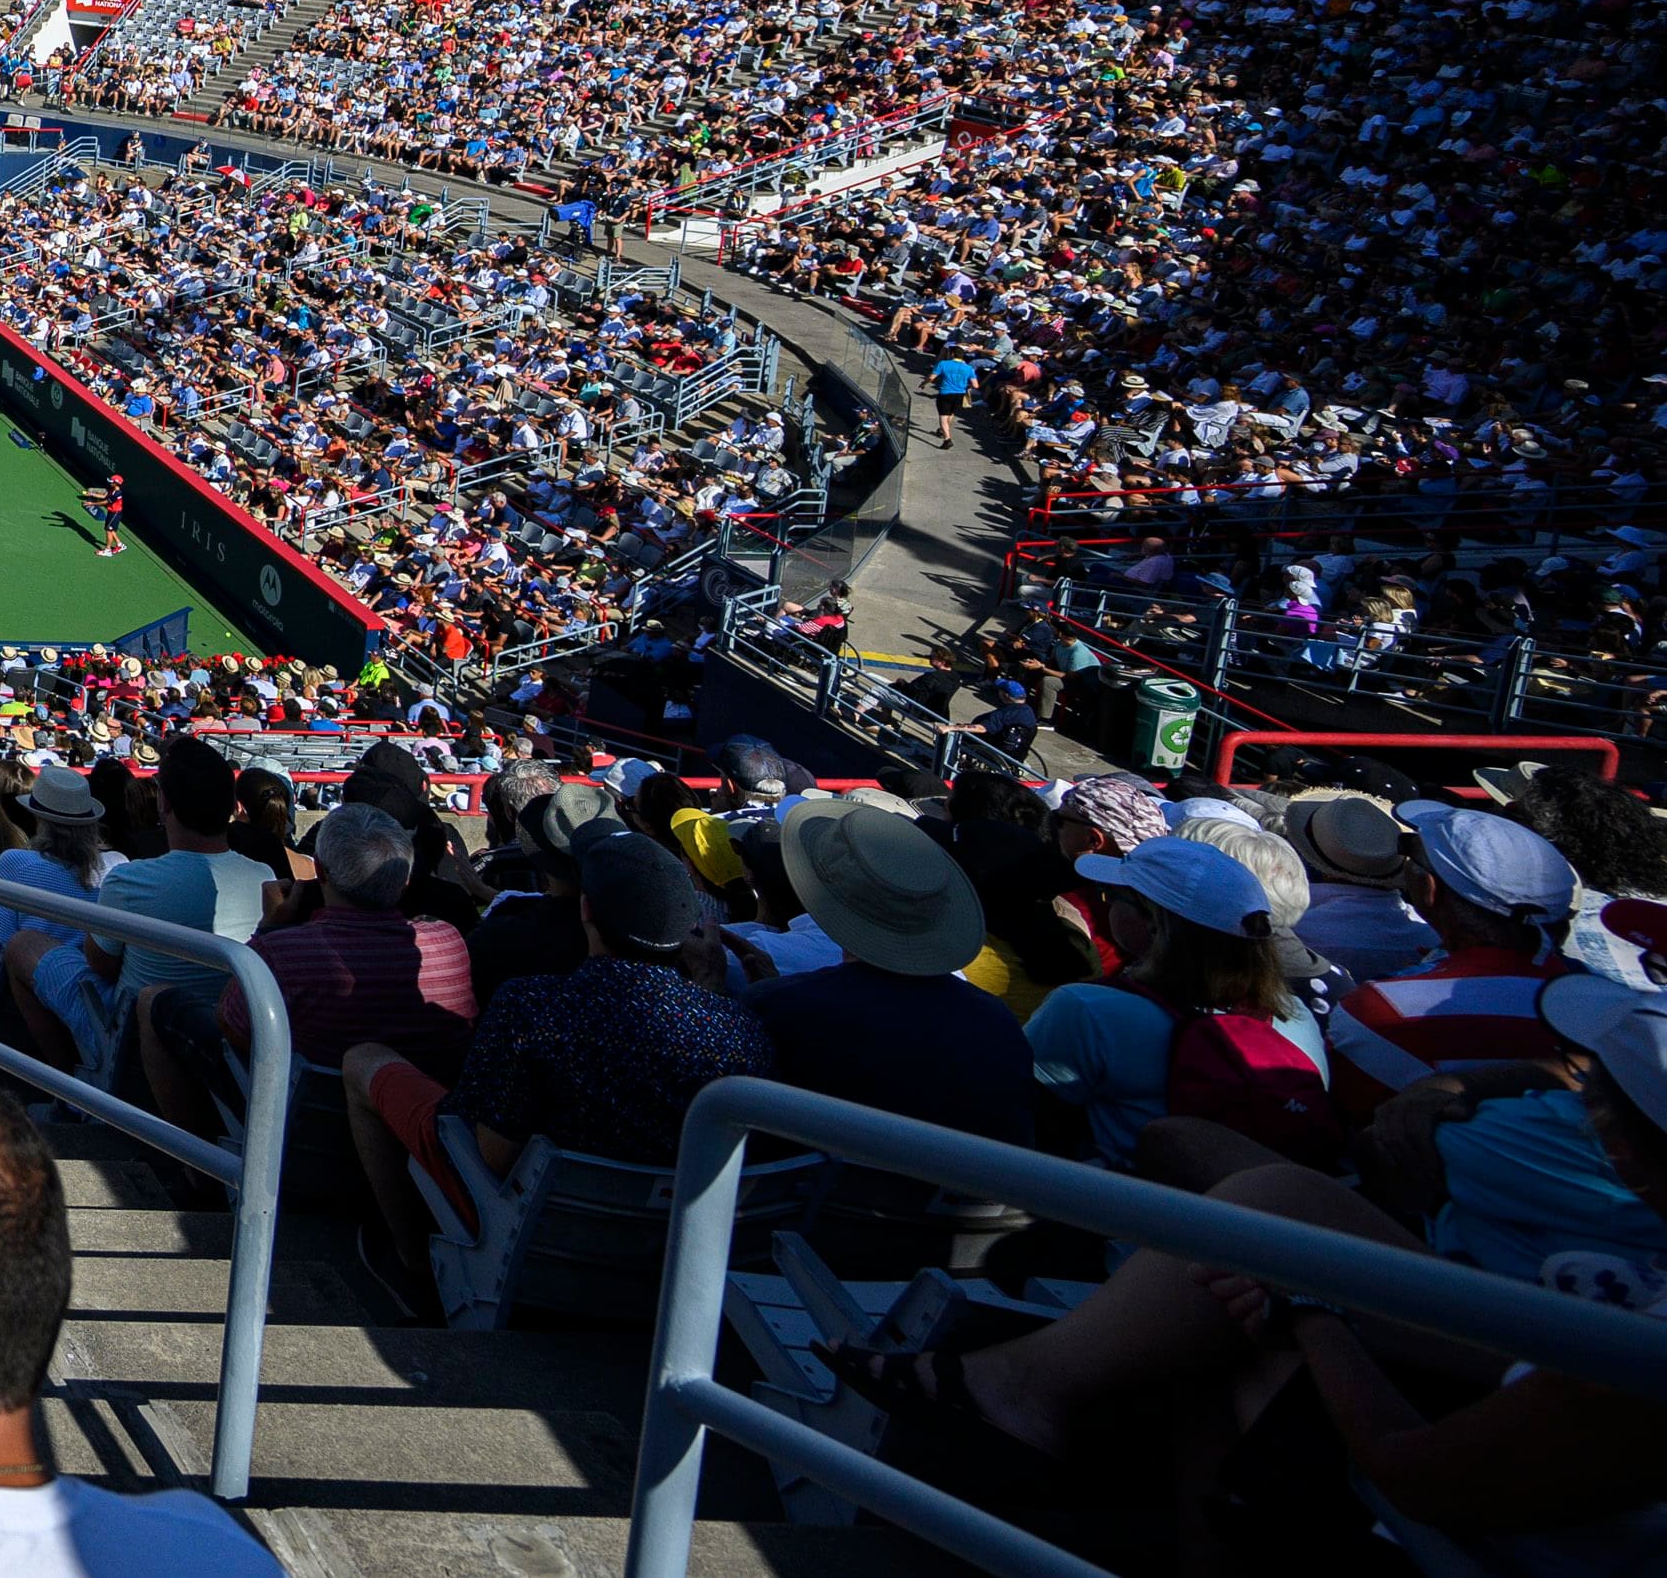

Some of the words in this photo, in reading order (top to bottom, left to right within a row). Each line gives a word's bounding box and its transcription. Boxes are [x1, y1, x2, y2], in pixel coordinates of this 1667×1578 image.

[15, 372, 34, 393] BANQUE
[15, 381, 40, 409] NATIONALE
[86, 441, 116, 472] NATIONALE
[87, 430, 109, 455] BANQUE
[180, 510, 226, 562] IRIS
[252, 598, 284, 633] motorola
